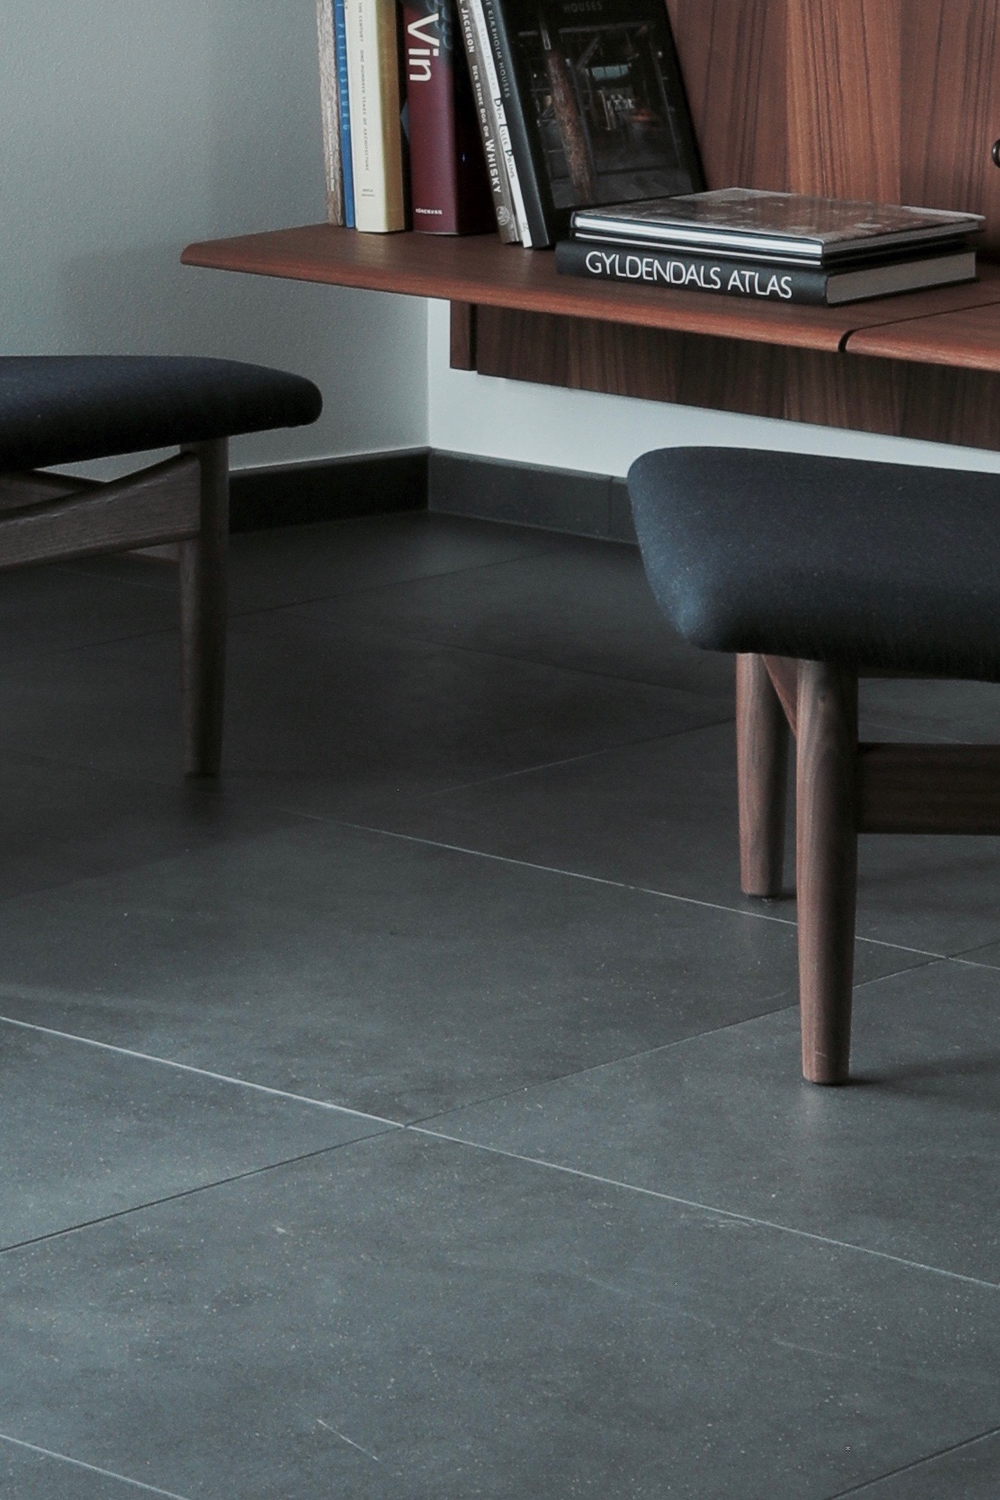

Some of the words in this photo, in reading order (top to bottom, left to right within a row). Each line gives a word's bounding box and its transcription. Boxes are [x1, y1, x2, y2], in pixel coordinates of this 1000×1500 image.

[407, 12, 442, 82] Vin
[459, 7, 475, 54] JACKSON
[483, 138, 502, 194] WHISKY
[584, 250, 723, 292] GYLDENDALS
[726, 268, 794, 299] ATLAS
